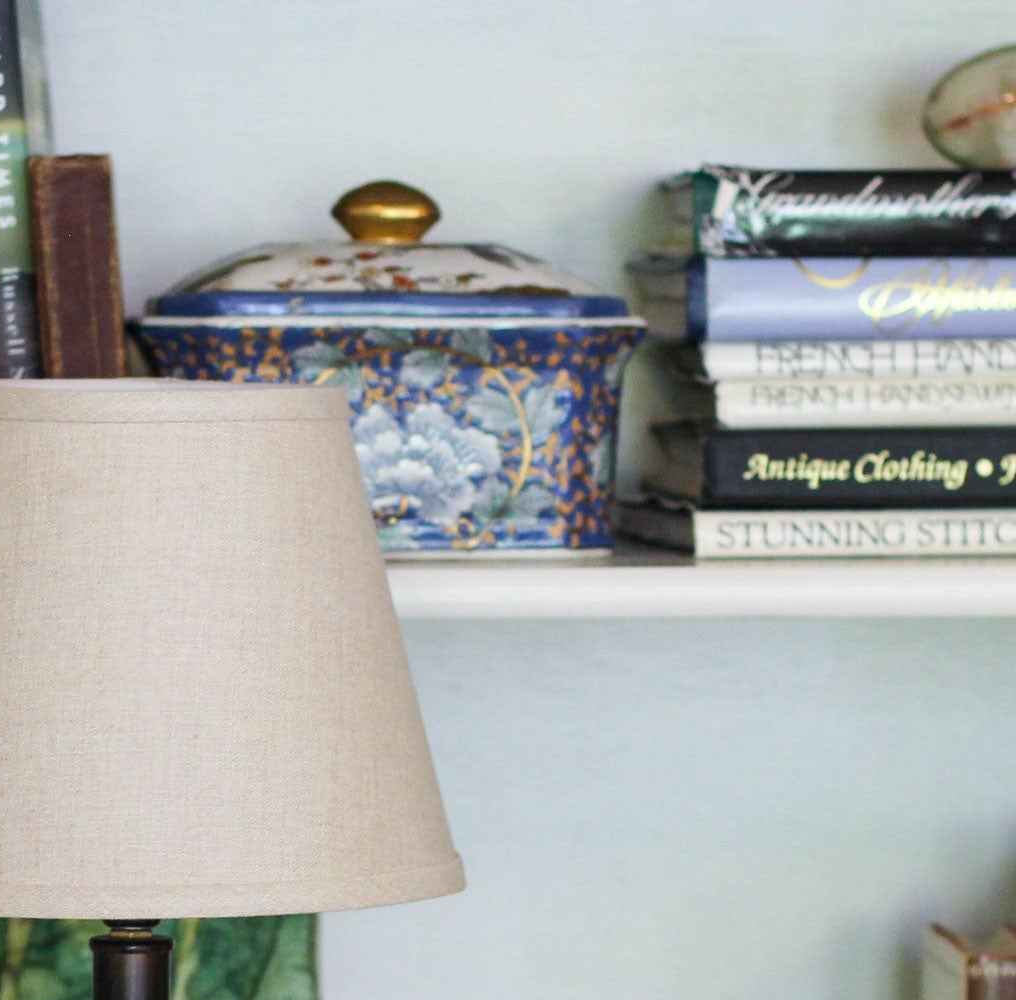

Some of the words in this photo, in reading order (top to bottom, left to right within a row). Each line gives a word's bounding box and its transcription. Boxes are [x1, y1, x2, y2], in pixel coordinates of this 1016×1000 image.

[755, 341, 896, 377] FRENCH
[742, 453, 851, 490] Antique
[854, 449, 969, 491] Clothing
[716, 519, 906, 549] STUNNING
